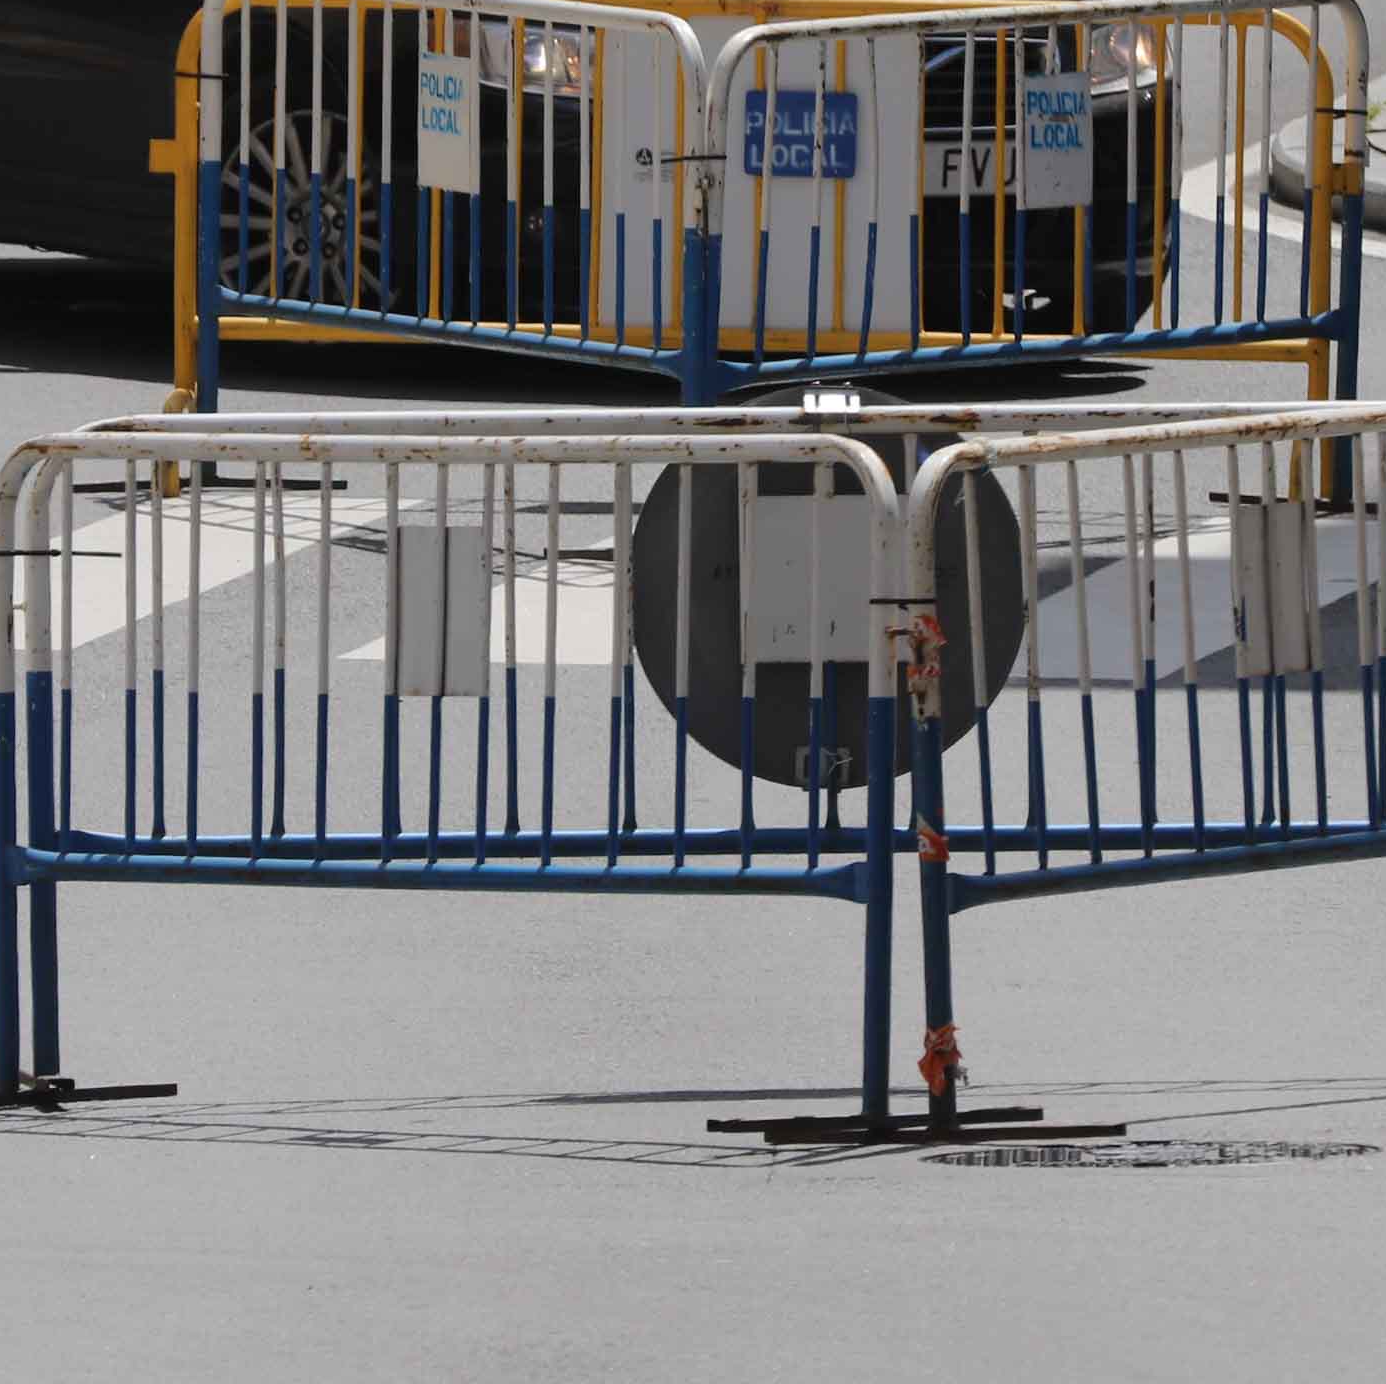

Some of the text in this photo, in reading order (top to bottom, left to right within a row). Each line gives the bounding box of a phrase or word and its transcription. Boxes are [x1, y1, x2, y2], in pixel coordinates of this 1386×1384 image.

[1026, 90, 1088, 115] POLICIA
[421, 106, 462, 135] LOCAL
[1030, 124, 1083, 150] LOCAL
